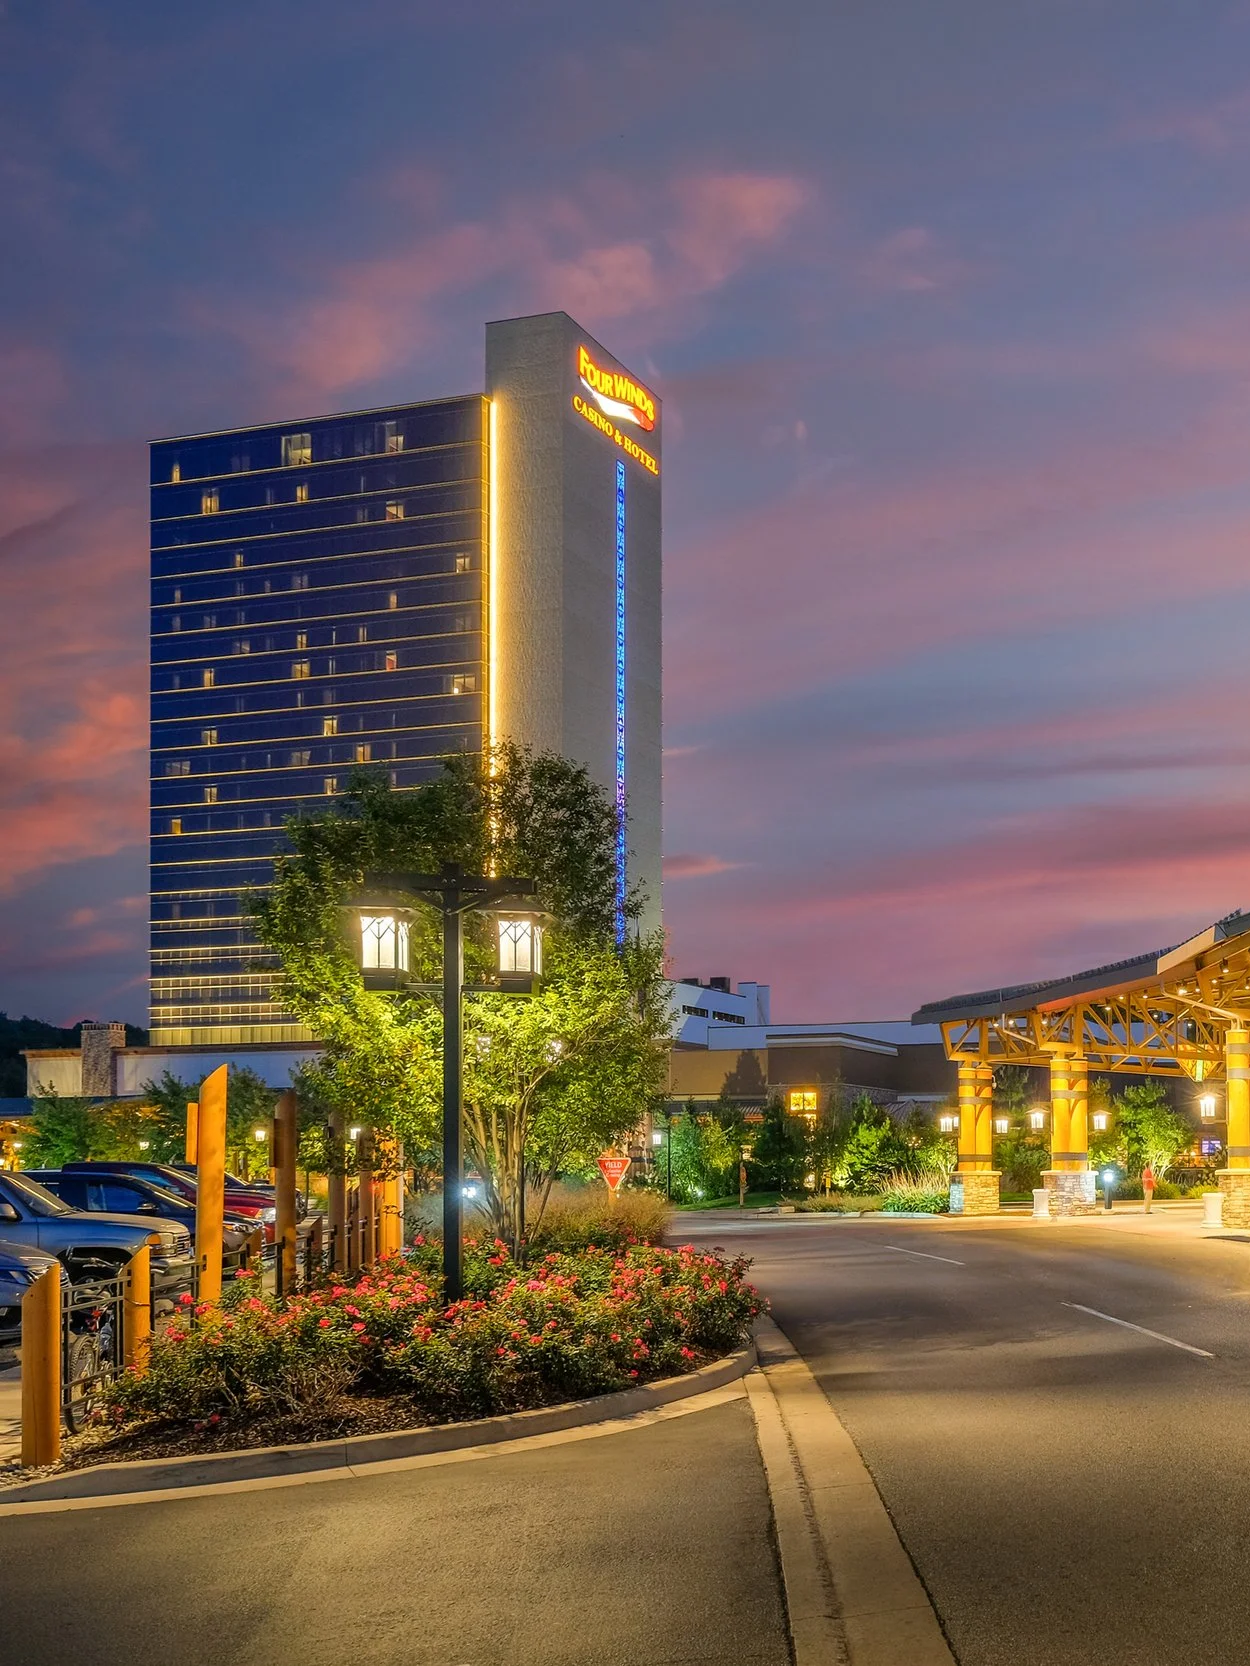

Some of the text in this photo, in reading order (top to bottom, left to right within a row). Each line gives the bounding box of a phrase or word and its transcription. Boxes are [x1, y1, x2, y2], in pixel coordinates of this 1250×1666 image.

[614, 373, 655, 422] WINDS
[573, 395, 659, 475] CASINO & HOTEL
